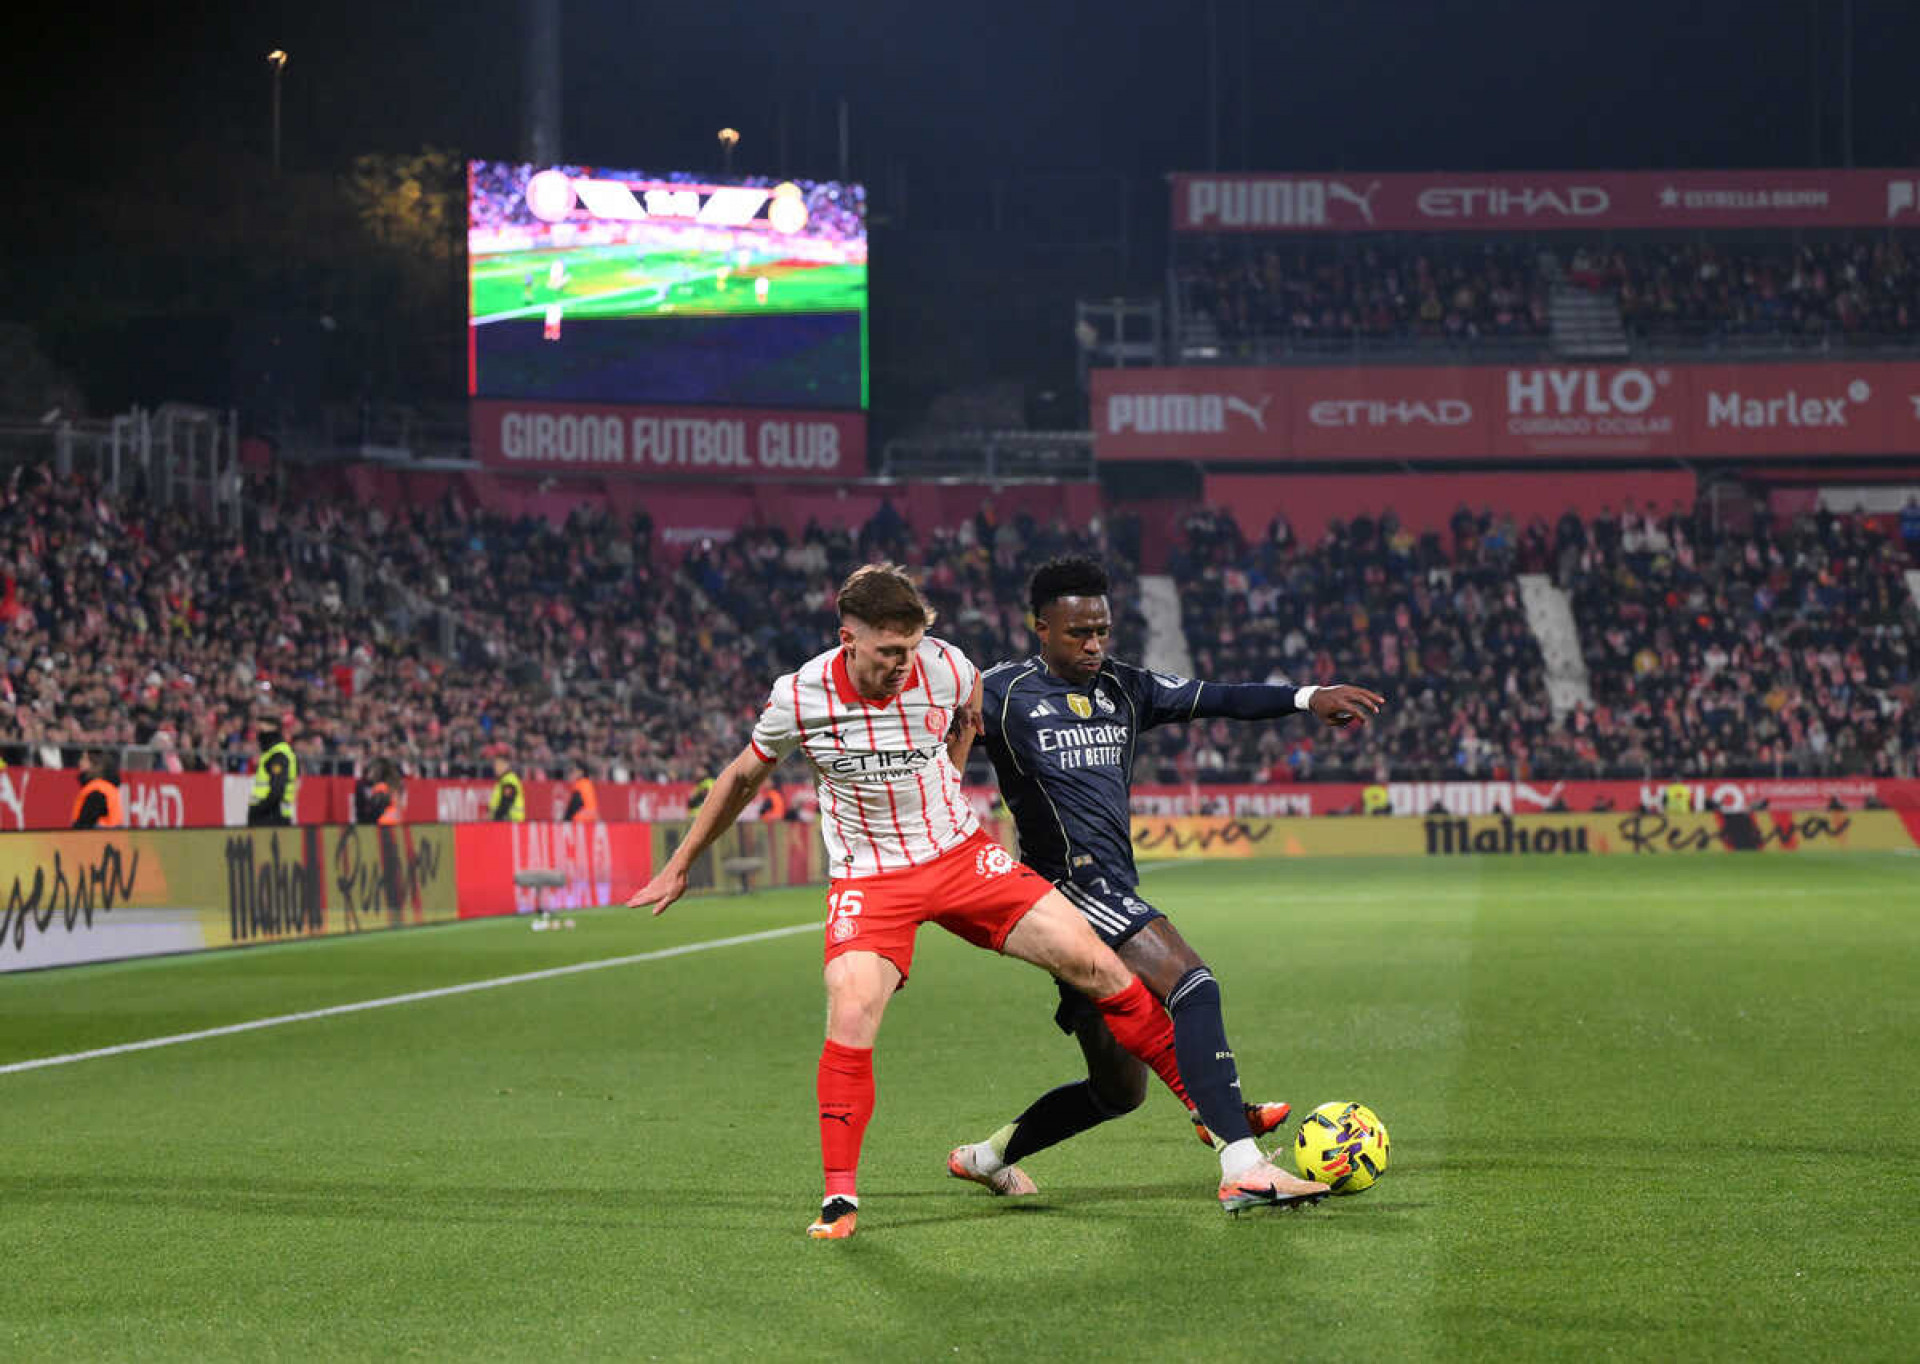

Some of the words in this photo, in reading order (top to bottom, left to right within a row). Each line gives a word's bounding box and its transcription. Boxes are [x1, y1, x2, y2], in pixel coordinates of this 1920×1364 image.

[1189, 181, 1325, 225] PUMA
[1417, 187, 1610, 216] ETIHAD
[1507, 369, 1656, 415] HYLO
[1108, 395, 1226, 434] PUMA
[1308, 399, 1473, 426] ETIHAD
[1706, 392, 1850, 428] Marlex
[502, 412, 625, 462] GIRONA
[632, 416, 753, 465] FUTBOL
[758, 421, 841, 468] CLUB
[1037, 723, 1128, 751] Emirates
[1060, 751, 1081, 769] FLY
[1640, 783, 1744, 813] HLO
[1134, 821, 1273, 850] erva
[1424, 813, 1589, 856] Mahou
[0, 843, 139, 952] serva
[828, 890, 865, 924] 15
